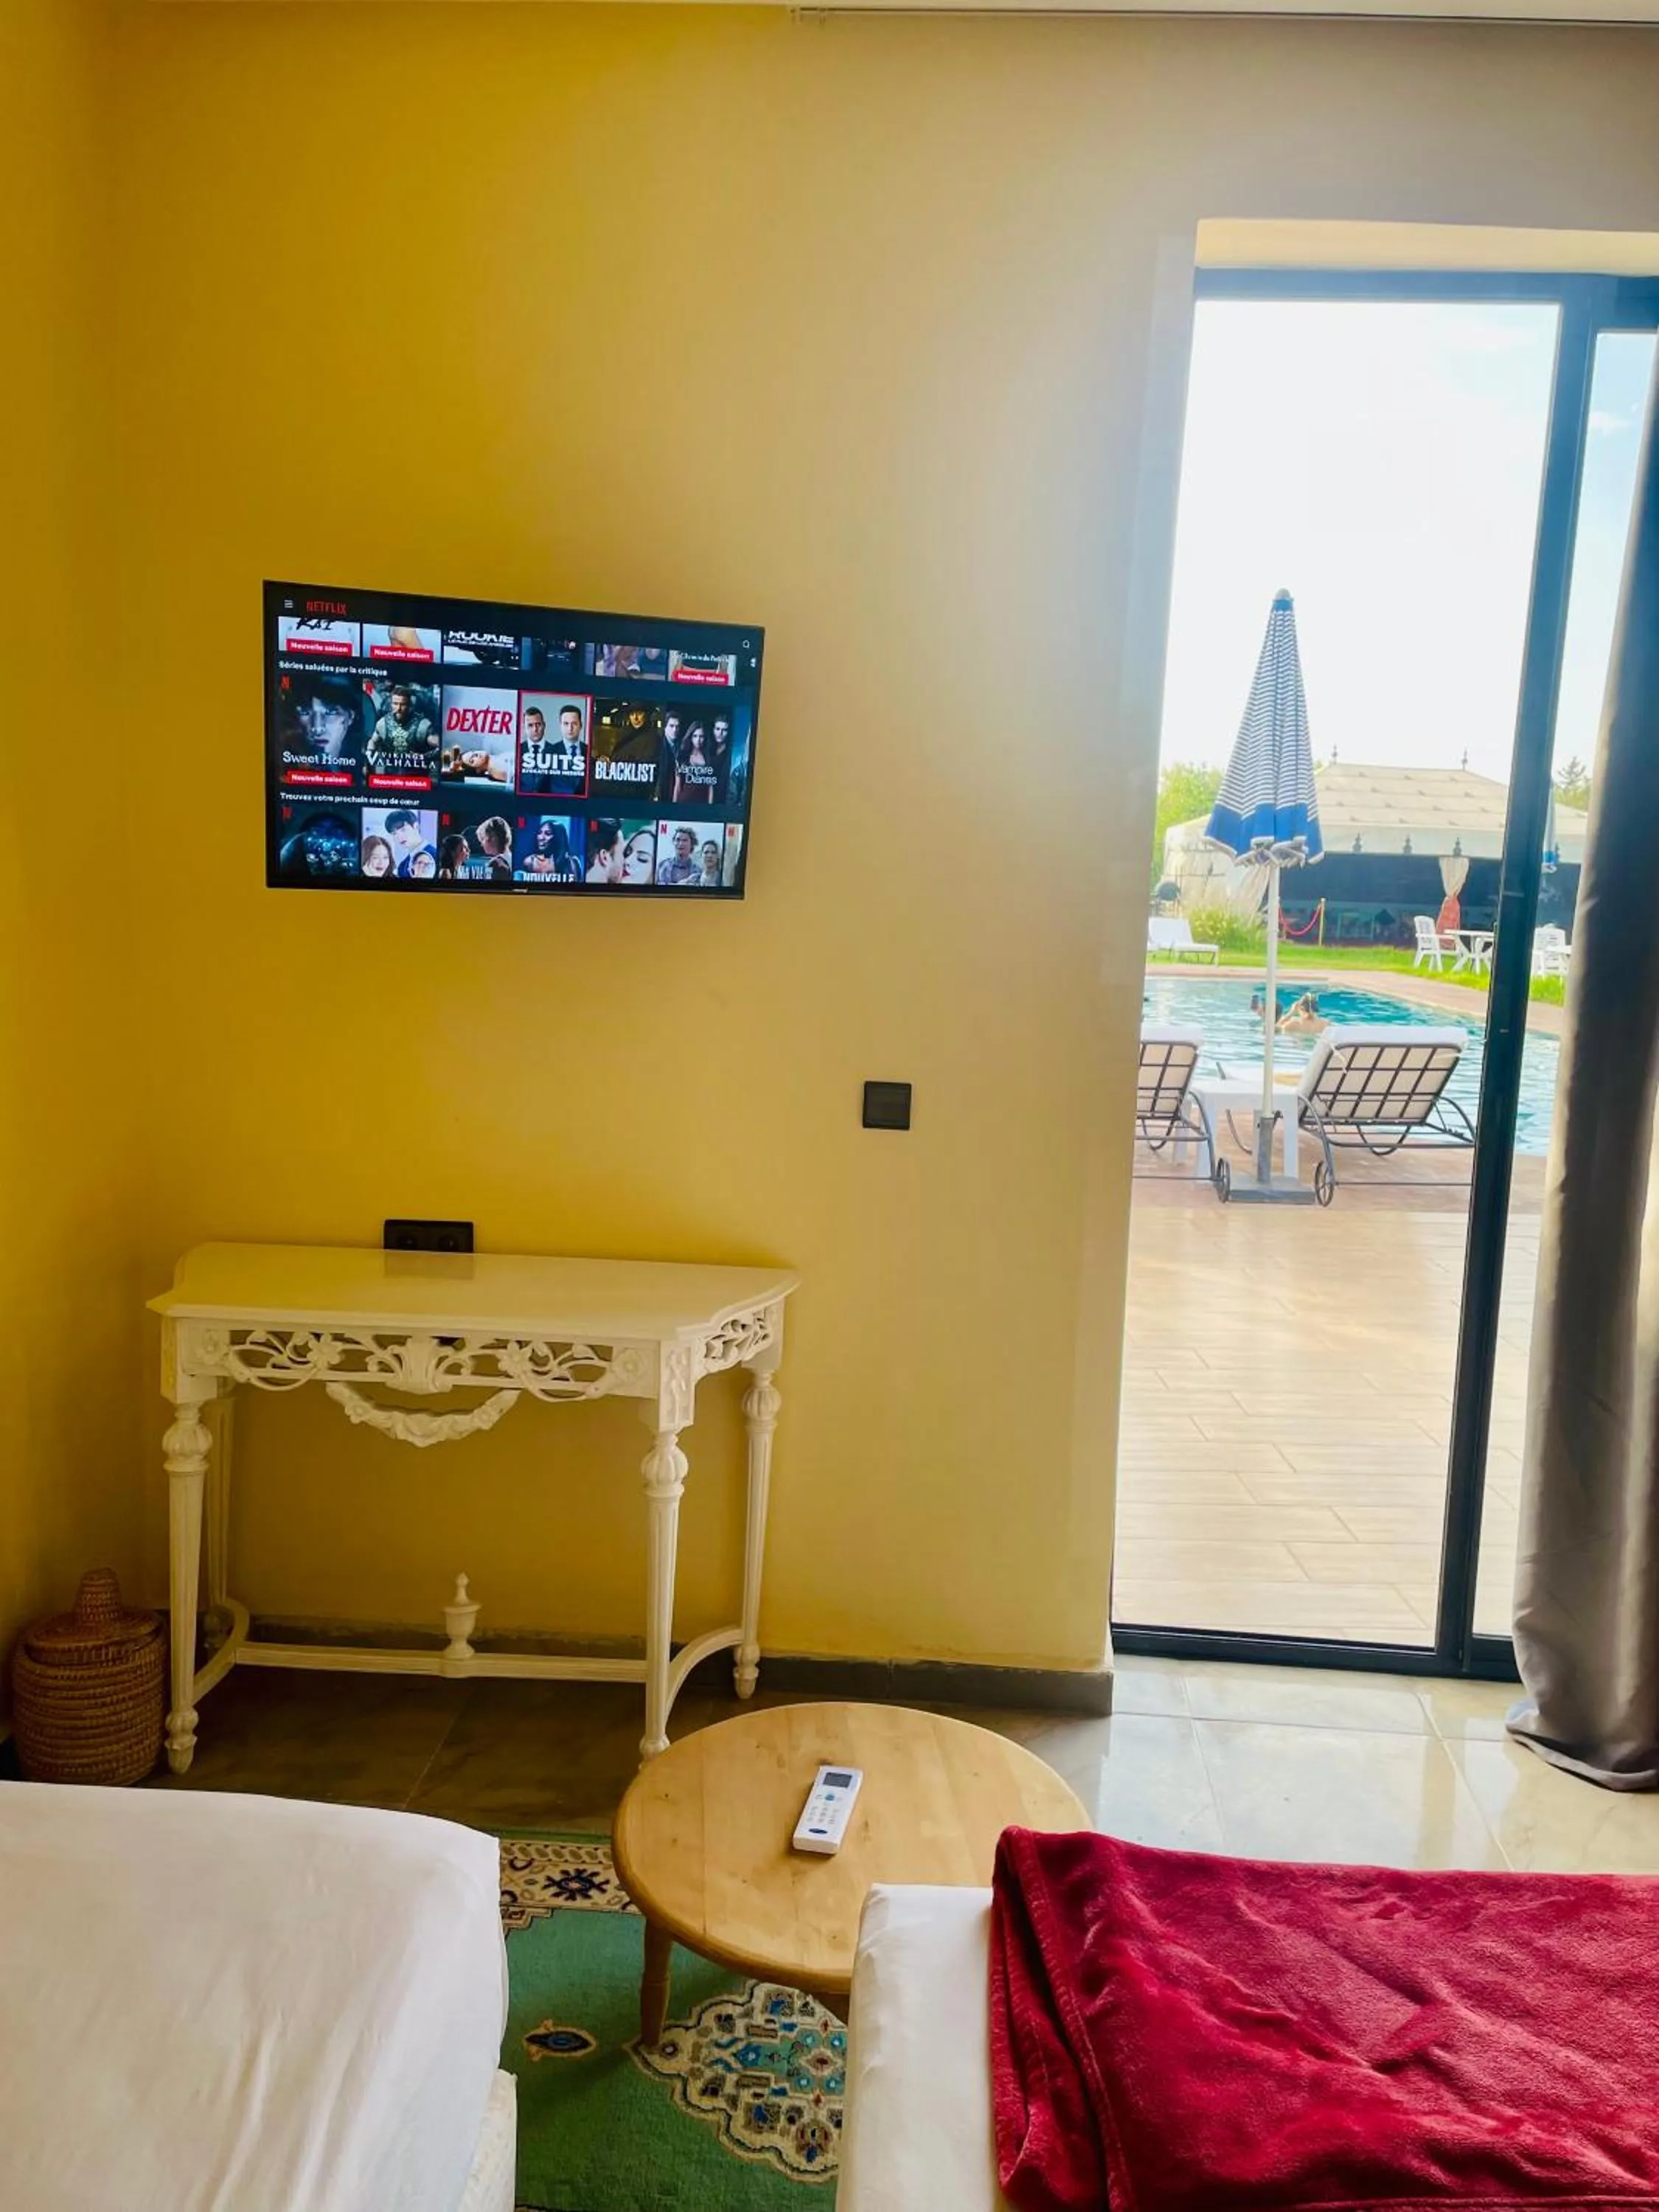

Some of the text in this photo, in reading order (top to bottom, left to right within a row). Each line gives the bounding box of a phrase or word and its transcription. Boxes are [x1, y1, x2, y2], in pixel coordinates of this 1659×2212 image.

[307, 601, 347, 615] NETFLIX
[279, 660, 304, 670] Séries
[305, 663, 334, 672] saluées
[335, 666, 349, 674] par
[358, 667, 388, 677] critique
[447, 704, 513, 734] DEXTER
[282, 751, 356, 766] Sweet Home
[366, 751, 437, 769] VALHALLA
[381, 752, 425, 760] VIKINGS
[522, 753, 585, 771] SUITS
[595, 760, 657, 782] BLACKLIST
[279, 792, 312, 801] Trouvez
[334, 795, 368, 803] prochain
